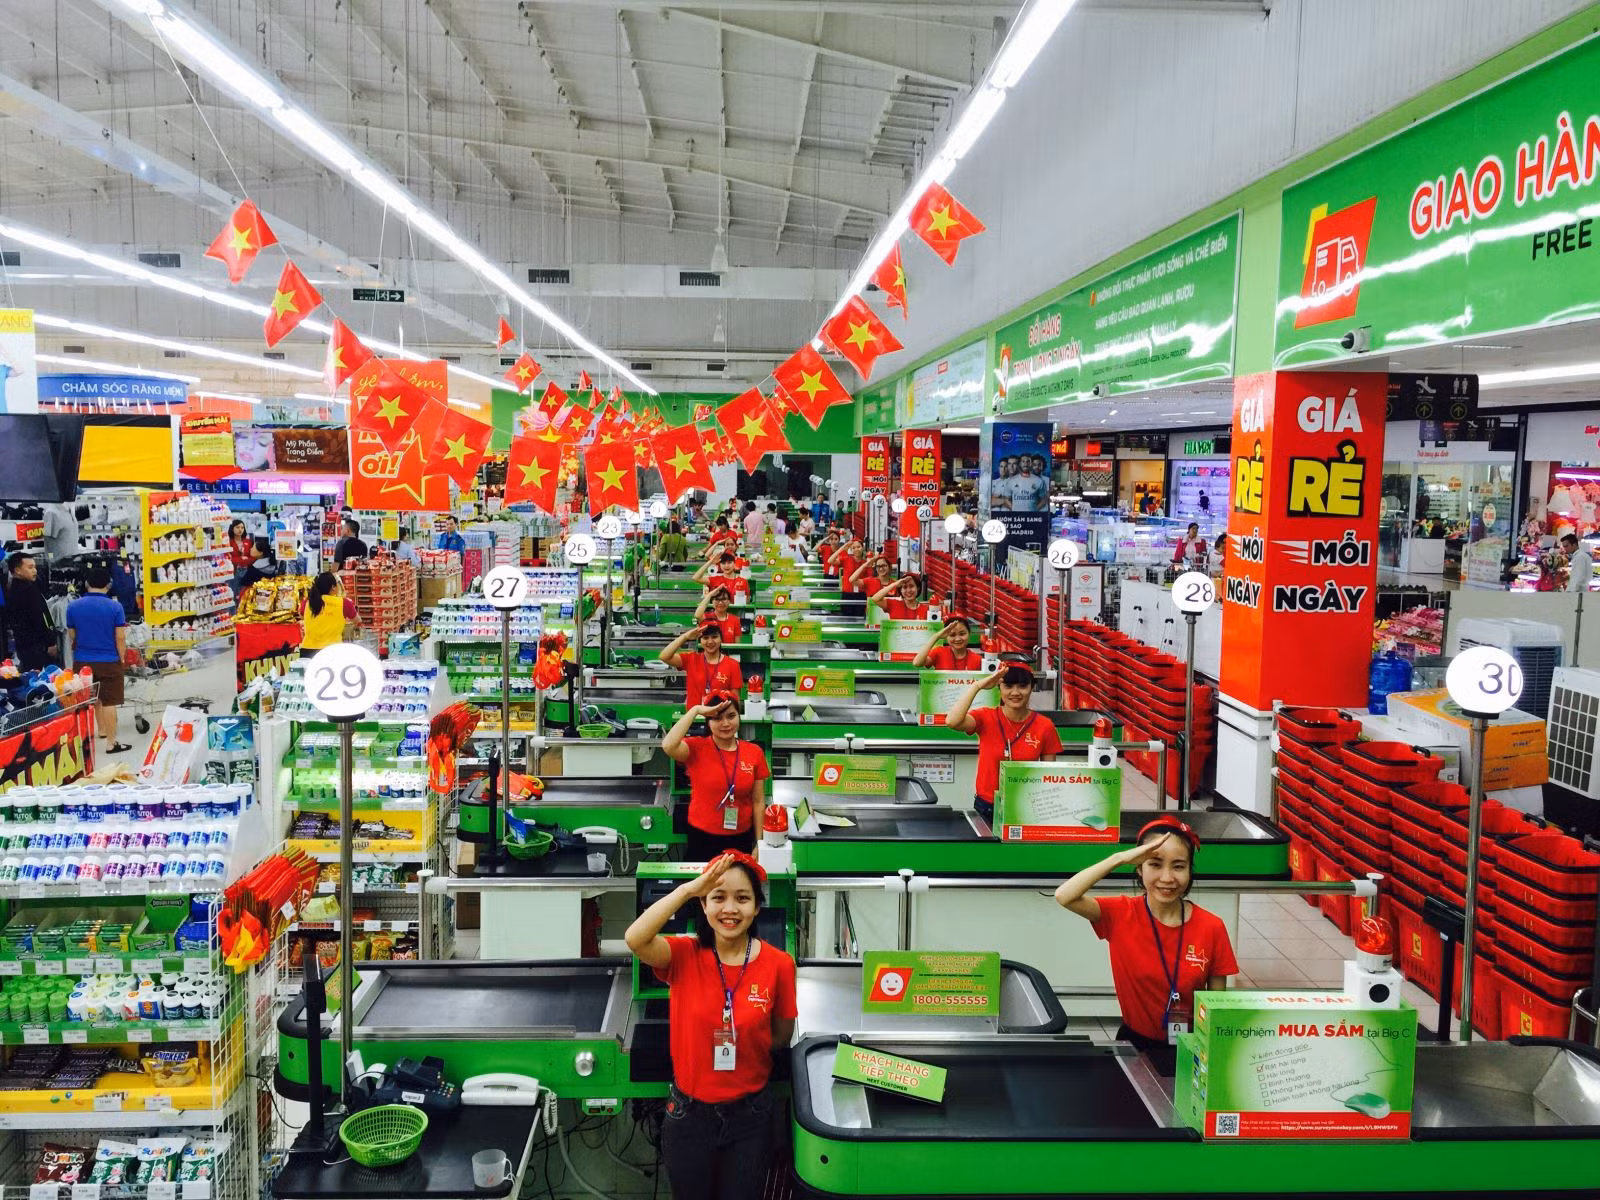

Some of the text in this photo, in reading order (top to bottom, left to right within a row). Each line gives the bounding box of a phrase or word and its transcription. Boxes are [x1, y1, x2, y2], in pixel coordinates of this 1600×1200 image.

[1410, 155, 1504, 239] GIAO
[1532, 218, 1593, 260] FREE
[1167, 253, 1184, 272] SỐNG
[1185, 246, 1194, 265] VÀ
[1195, 238, 1210, 262] CHẾ
[1210, 232, 1228, 256] BIẾN
[1041, 312, 1061, 343] HÀNG
[62, 382, 98, 393] CHĂM
[102, 382, 128, 394] SÓC
[132, 383, 161, 395] RĂNG
[354, 374, 378, 396] yê
[1240, 388, 1265, 433] GIÁ
[1297, 388, 1363, 433] GIÁ
[286, 438, 317, 448] Mỹ Phẩm
[286, 447, 324, 457] Trang Điểm
[868, 441, 884, 452] GIÁ
[913, 436, 934, 450] GIÁ
[866, 454, 885, 471] RẺ
[911, 453, 935, 476] RẺ
[918, 479, 938, 492] MỖI
[1234, 439, 1265, 514] RẺ
[1287, 440, 1366, 517] RẺ
[907, 496, 936, 507] NGÀY
[920, 509, 931, 517] 20
[602, 522, 618, 534] 23
[568, 542, 588, 557] 25
[1240, 527, 1265, 564] MỖI
[1312, 530, 1370, 566] MỖI
[1051, 550, 1072, 565] 26
[490, 577, 520, 598] 27
[1185, 582, 1213, 602] 28
[1226, 576, 1261, 608] NGÀY
[1273, 580, 1367, 612] NGÀY
[314, 664, 367, 701] 29
[1478, 662, 1523, 697] 30
[1069, 772, 1092, 784] SẮM
[912, 994, 988, 1006] 1800-555555
[1215, 1019, 1410, 1039] Trải nghiệm MUA SẮM tại Big C
[153, 1050, 189, 1063] SNICKERS
[866, 1077, 908, 1092] NEXT CUSTOMER
[888, 1071, 919, 1088] THEO
